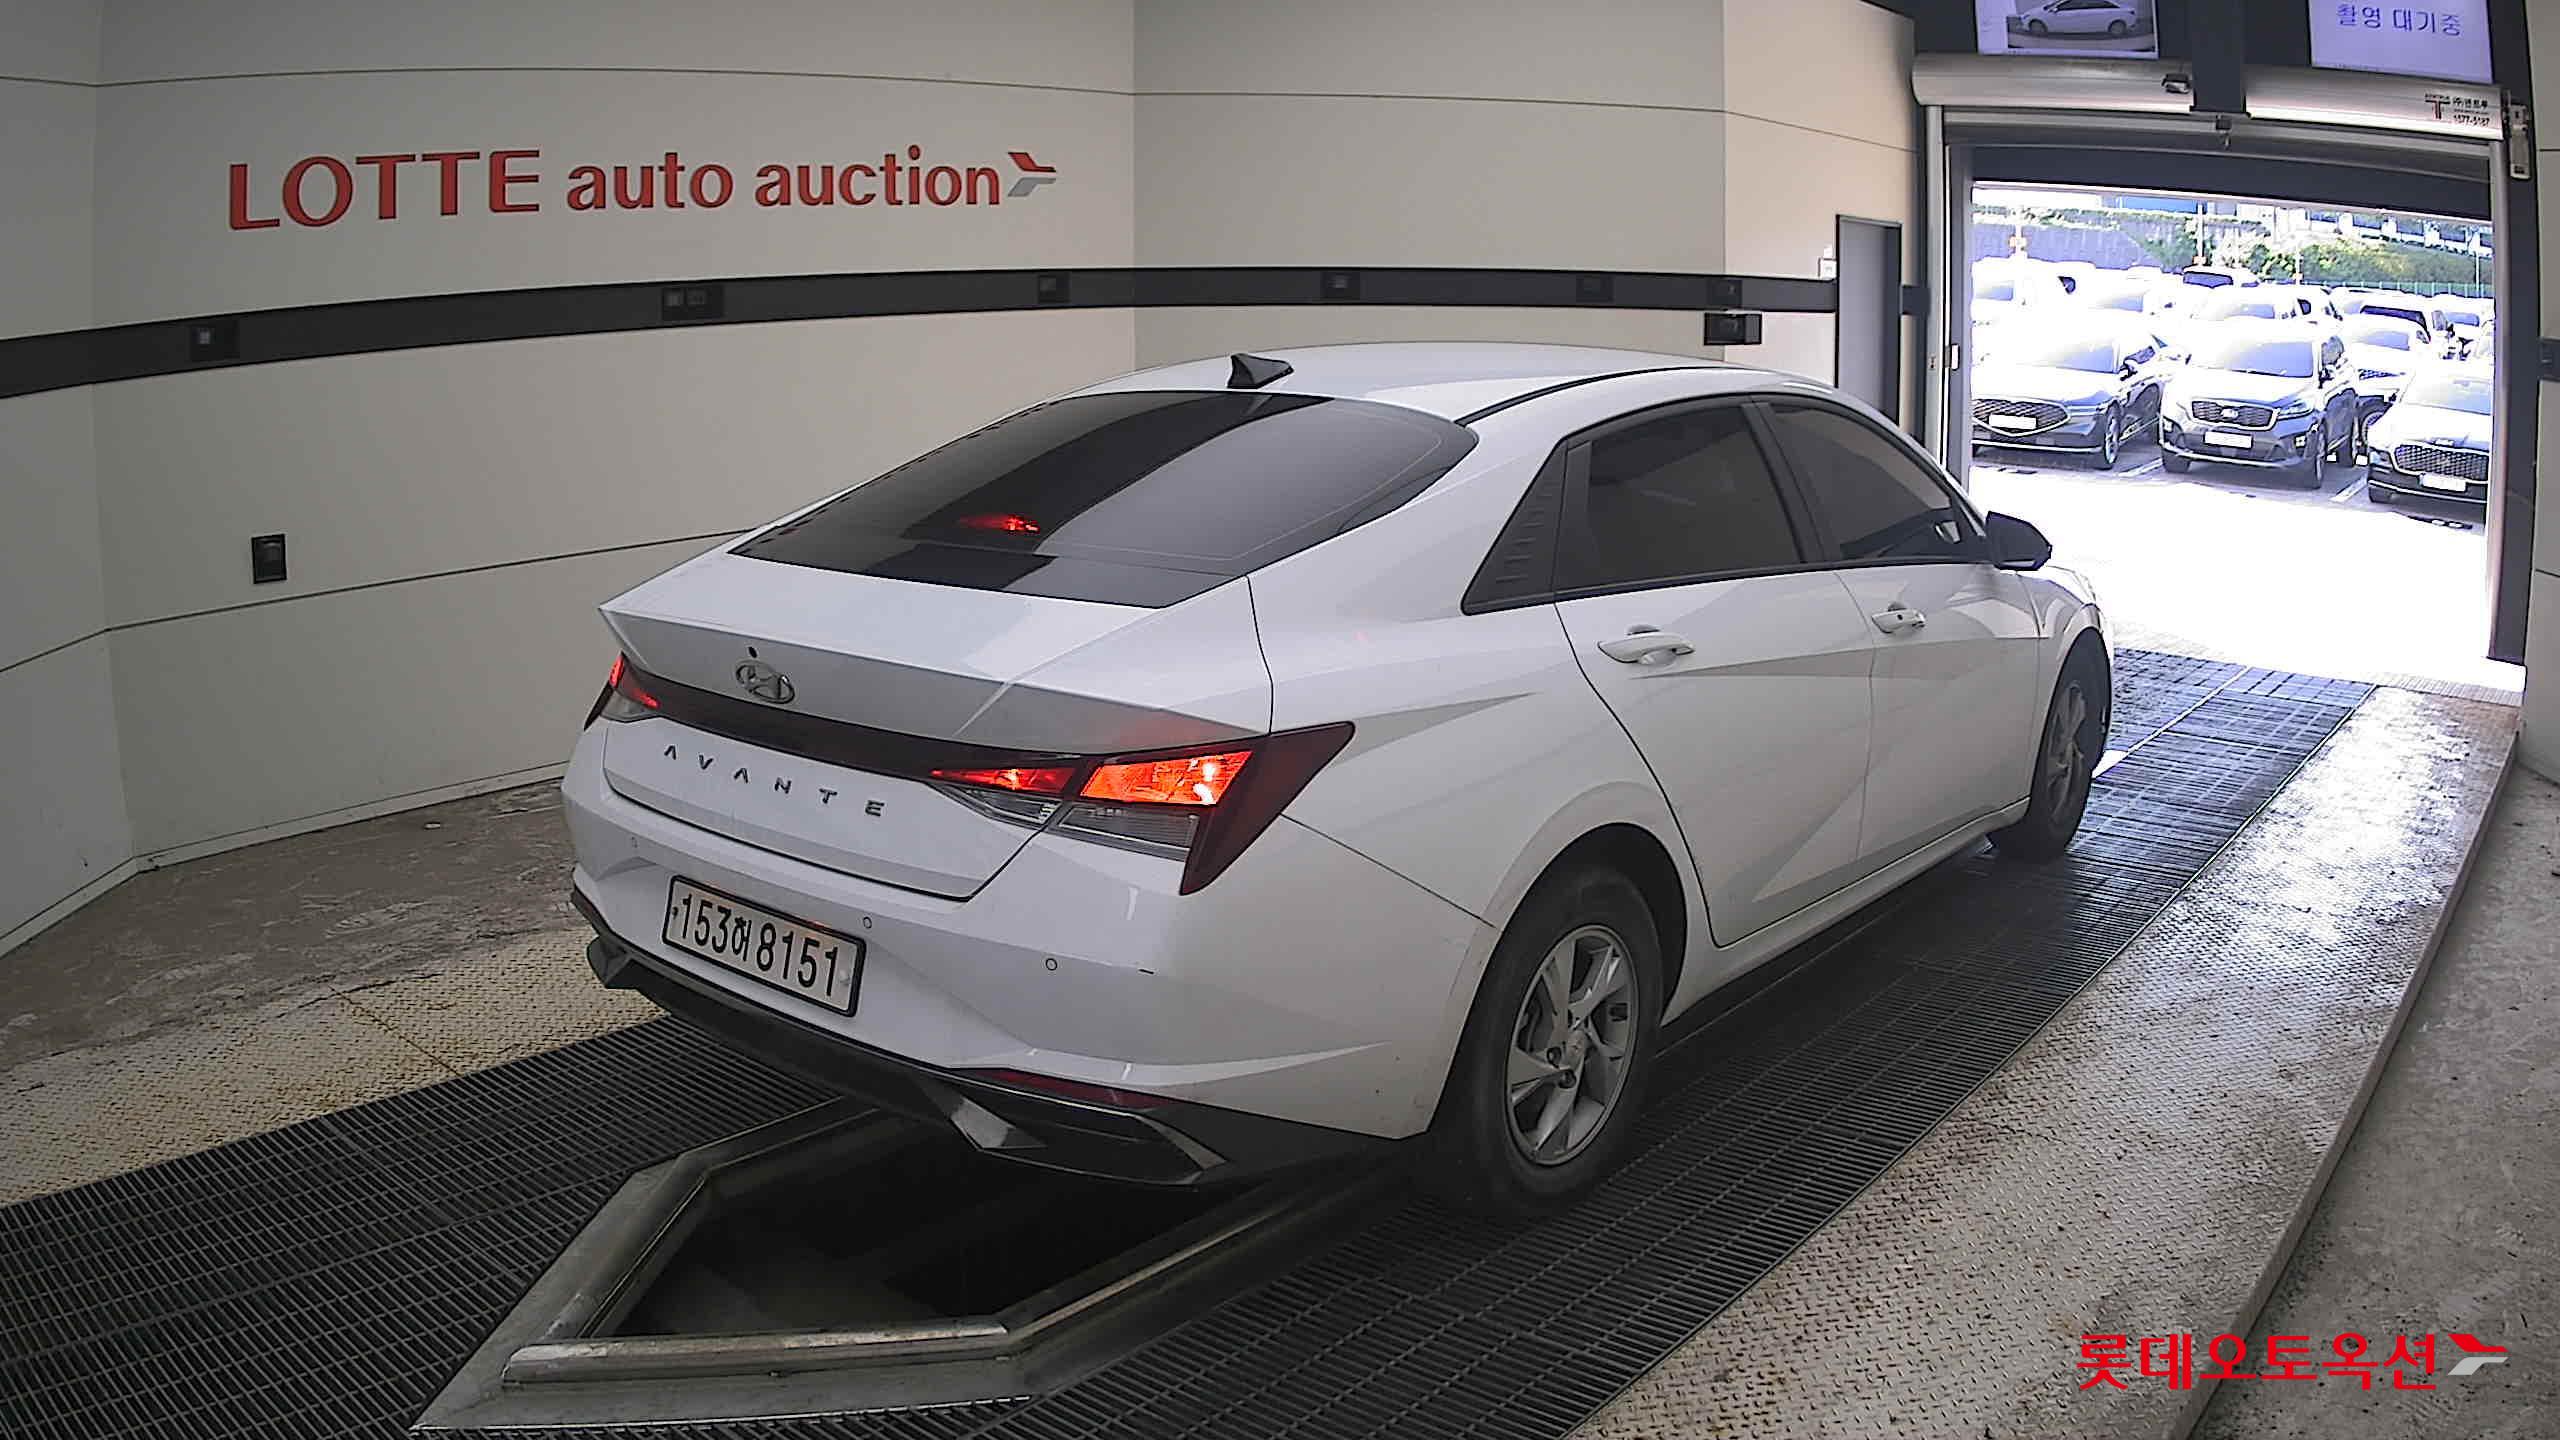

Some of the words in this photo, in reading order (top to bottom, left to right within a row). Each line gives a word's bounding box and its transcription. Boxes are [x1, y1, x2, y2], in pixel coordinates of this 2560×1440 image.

[2337, 4, 2382, 29] 촬영
[2393, 8, 2461, 36] 대기중
[229, 150, 541, 231] LOTTE
[567, 152, 735, 211] auto
[754, 144, 1001, 207] auction
[663, 743, 886, 818] AVANTE
[682, 892, 840, 997] 153허8151
